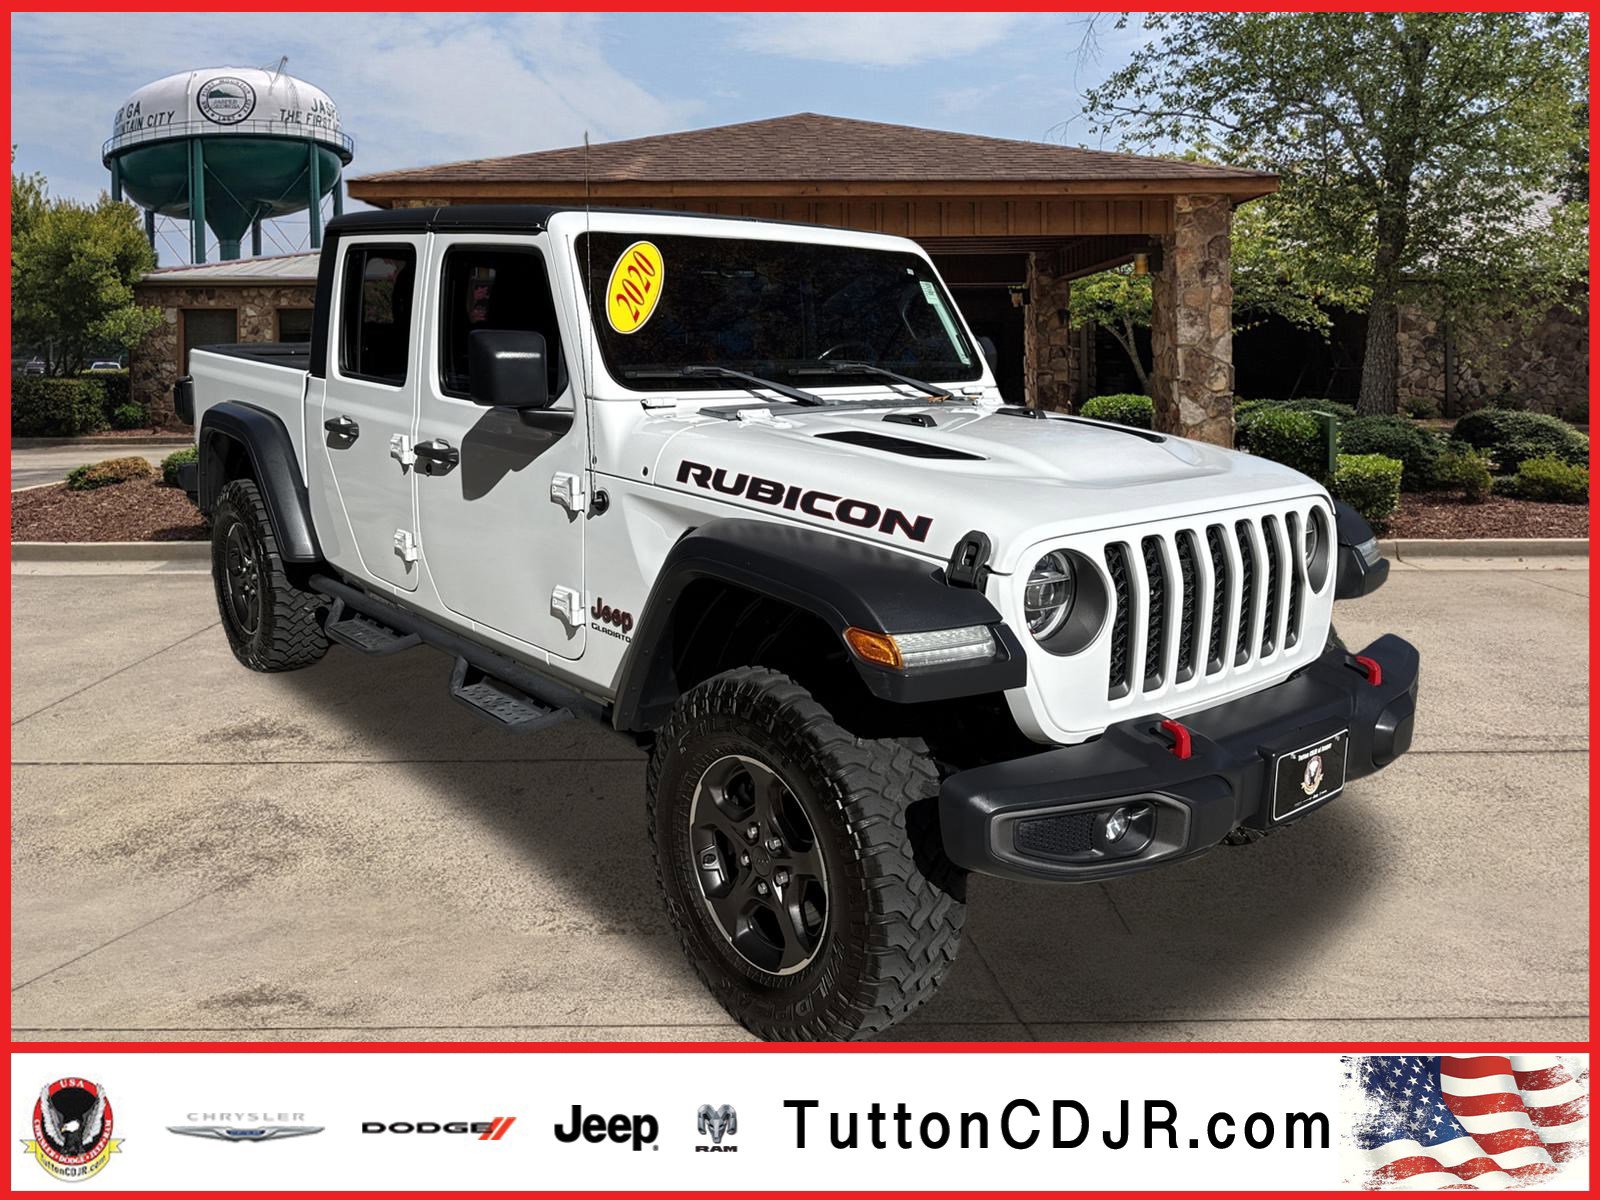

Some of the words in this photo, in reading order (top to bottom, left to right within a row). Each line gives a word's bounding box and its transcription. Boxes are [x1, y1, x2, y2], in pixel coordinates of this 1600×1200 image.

[127, 101, 140, 119] GA
[147, 110, 175, 127] CITY
[280, 109, 301, 124] THE
[306, 112, 332, 129] FIRST
[616, 250, 655, 323] 2020
[676, 460, 933, 543] RUBICON
[591, 597, 633, 634] Jeep
[591, 622, 632, 643] GLADIATO
